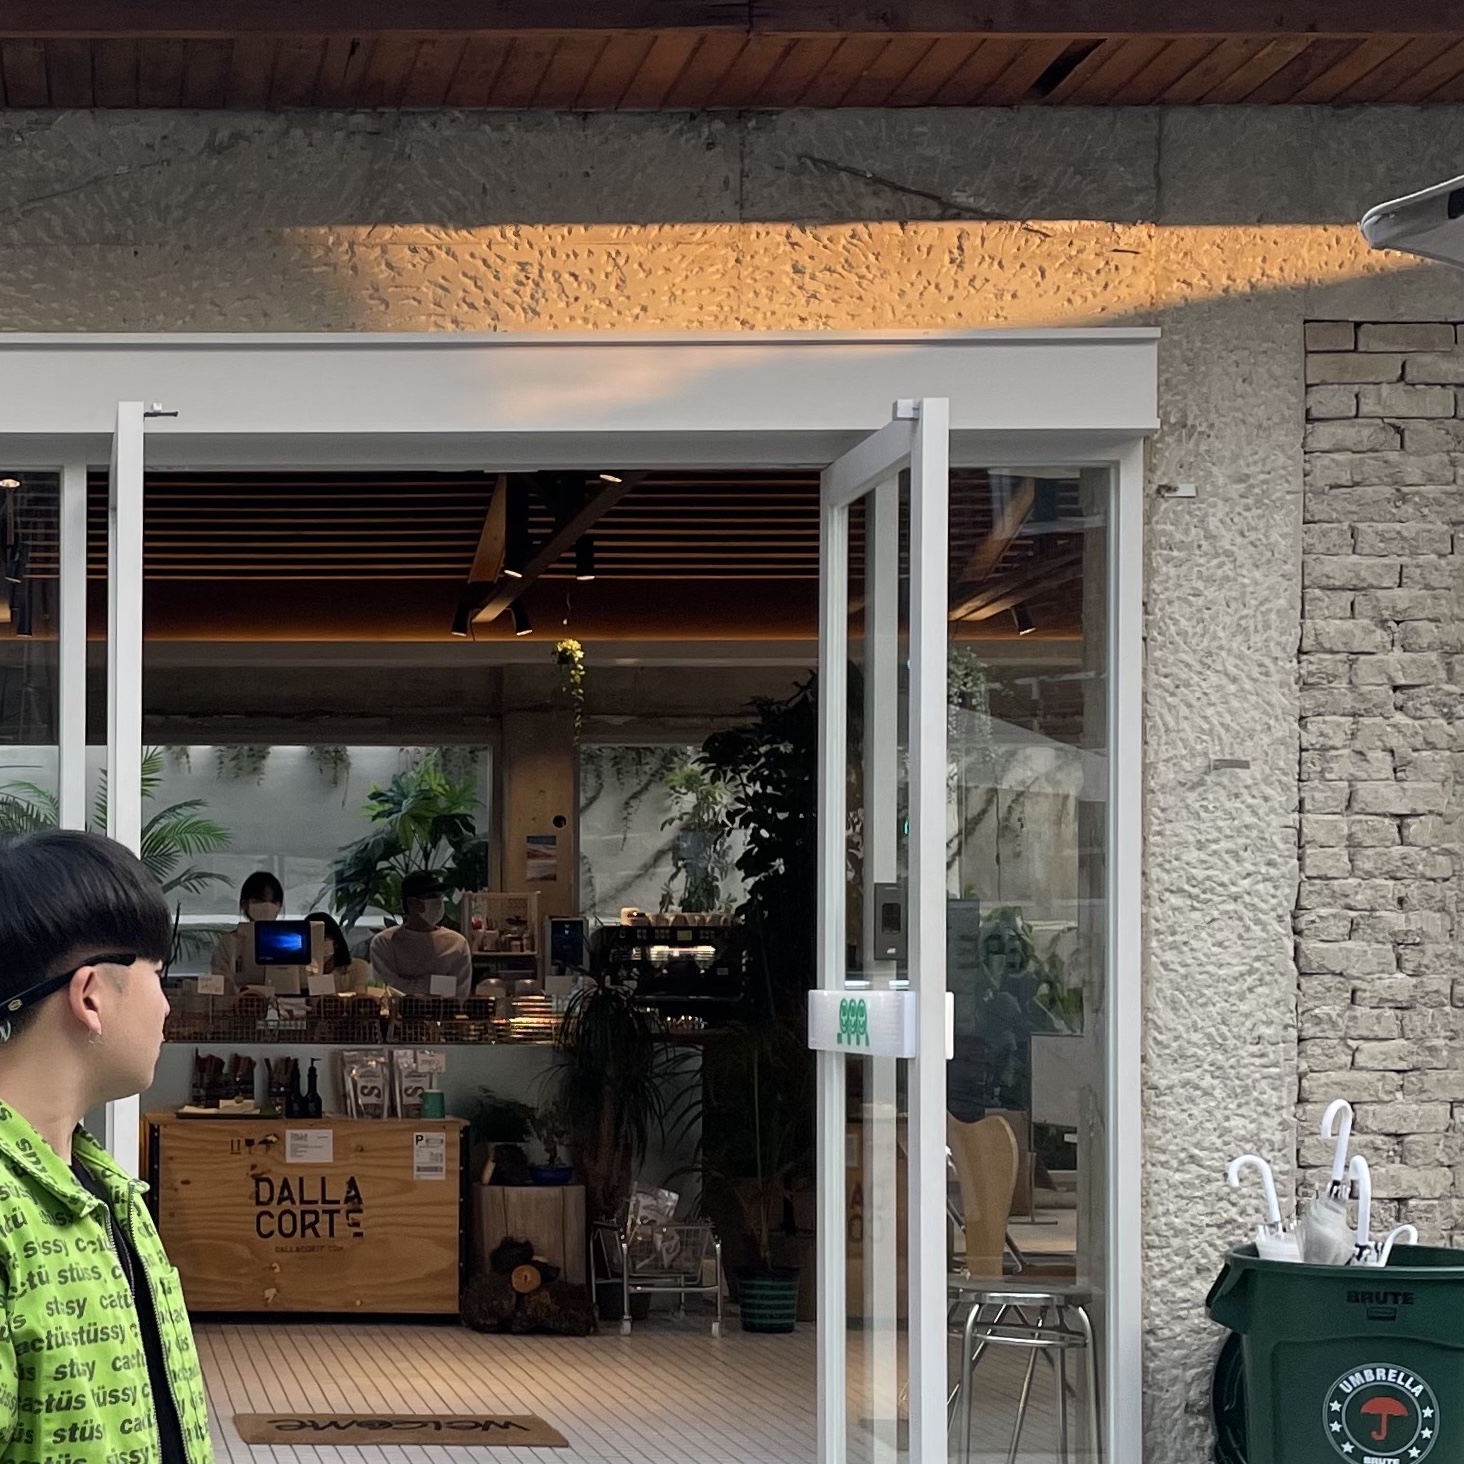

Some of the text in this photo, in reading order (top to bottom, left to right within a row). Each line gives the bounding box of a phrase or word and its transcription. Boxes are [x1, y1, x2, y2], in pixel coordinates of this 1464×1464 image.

[416, 1135, 424, 1146] P
[254, 1175, 364, 1207] DALLA
[1338, 1367, 1426, 1397] UMBRELLA
